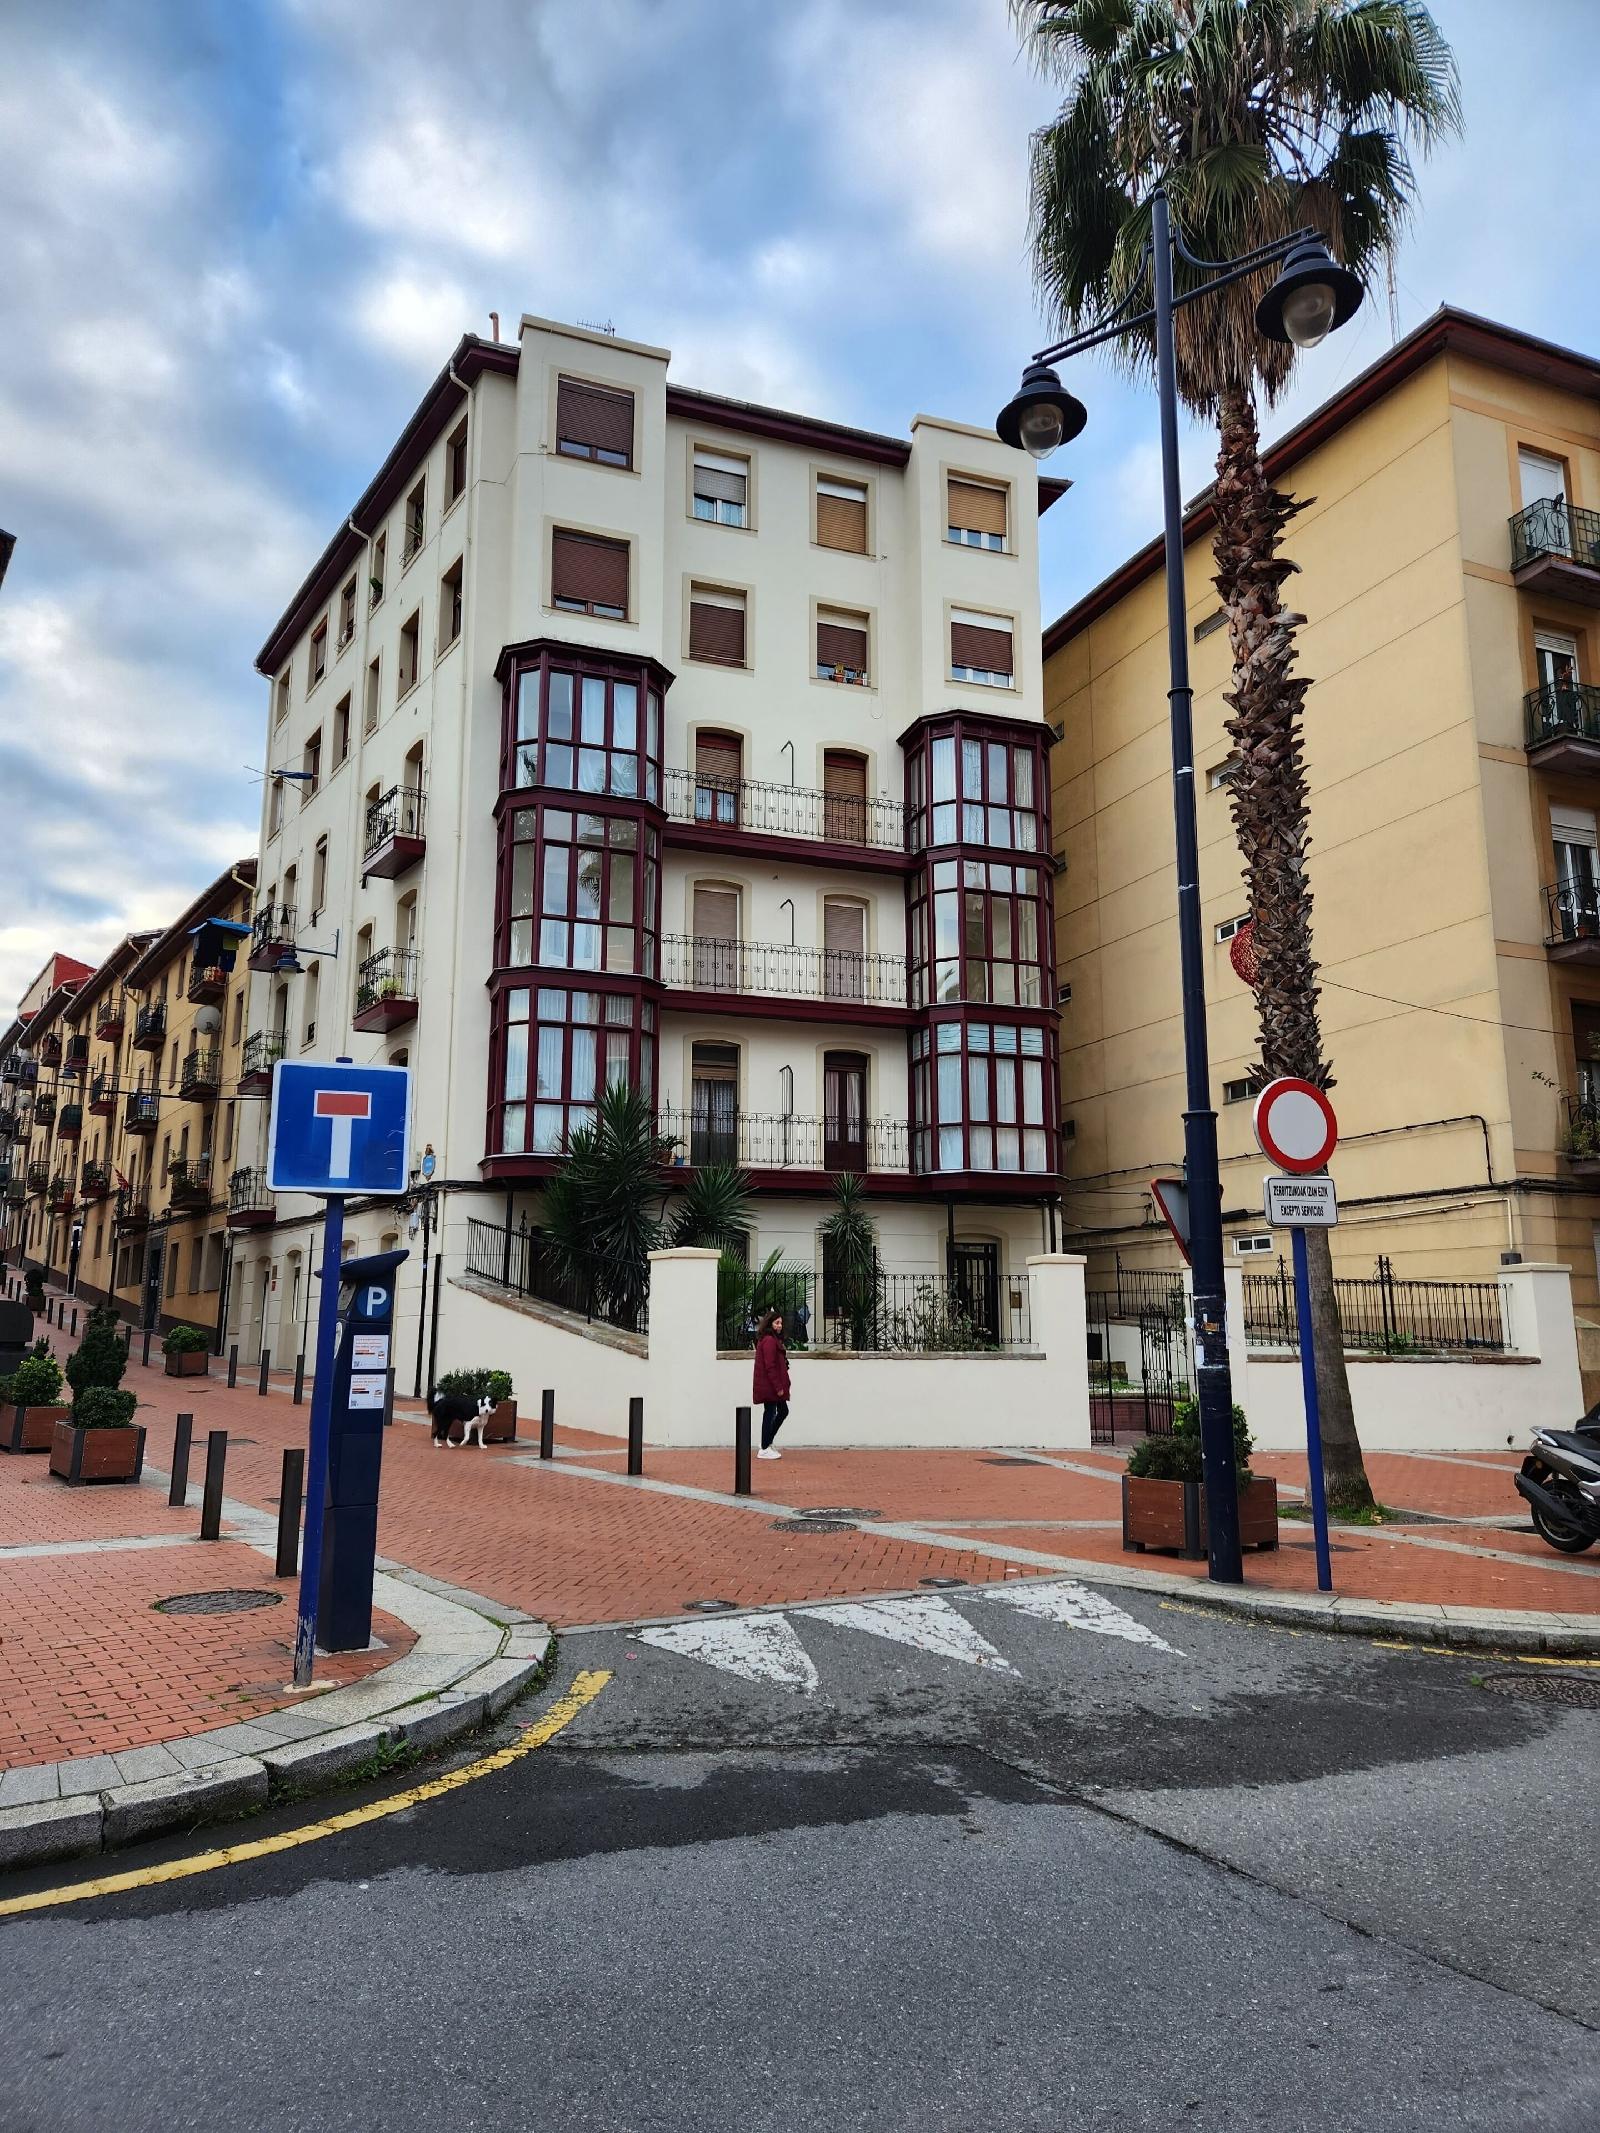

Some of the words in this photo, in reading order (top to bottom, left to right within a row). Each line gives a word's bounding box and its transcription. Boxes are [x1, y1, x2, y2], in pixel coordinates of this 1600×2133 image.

[1281, 1205, 1300, 1216] EXCEPTO
[1301, 1205, 1324, 1216] SERVICIOS
[366, 1286, 387, 1316] P
